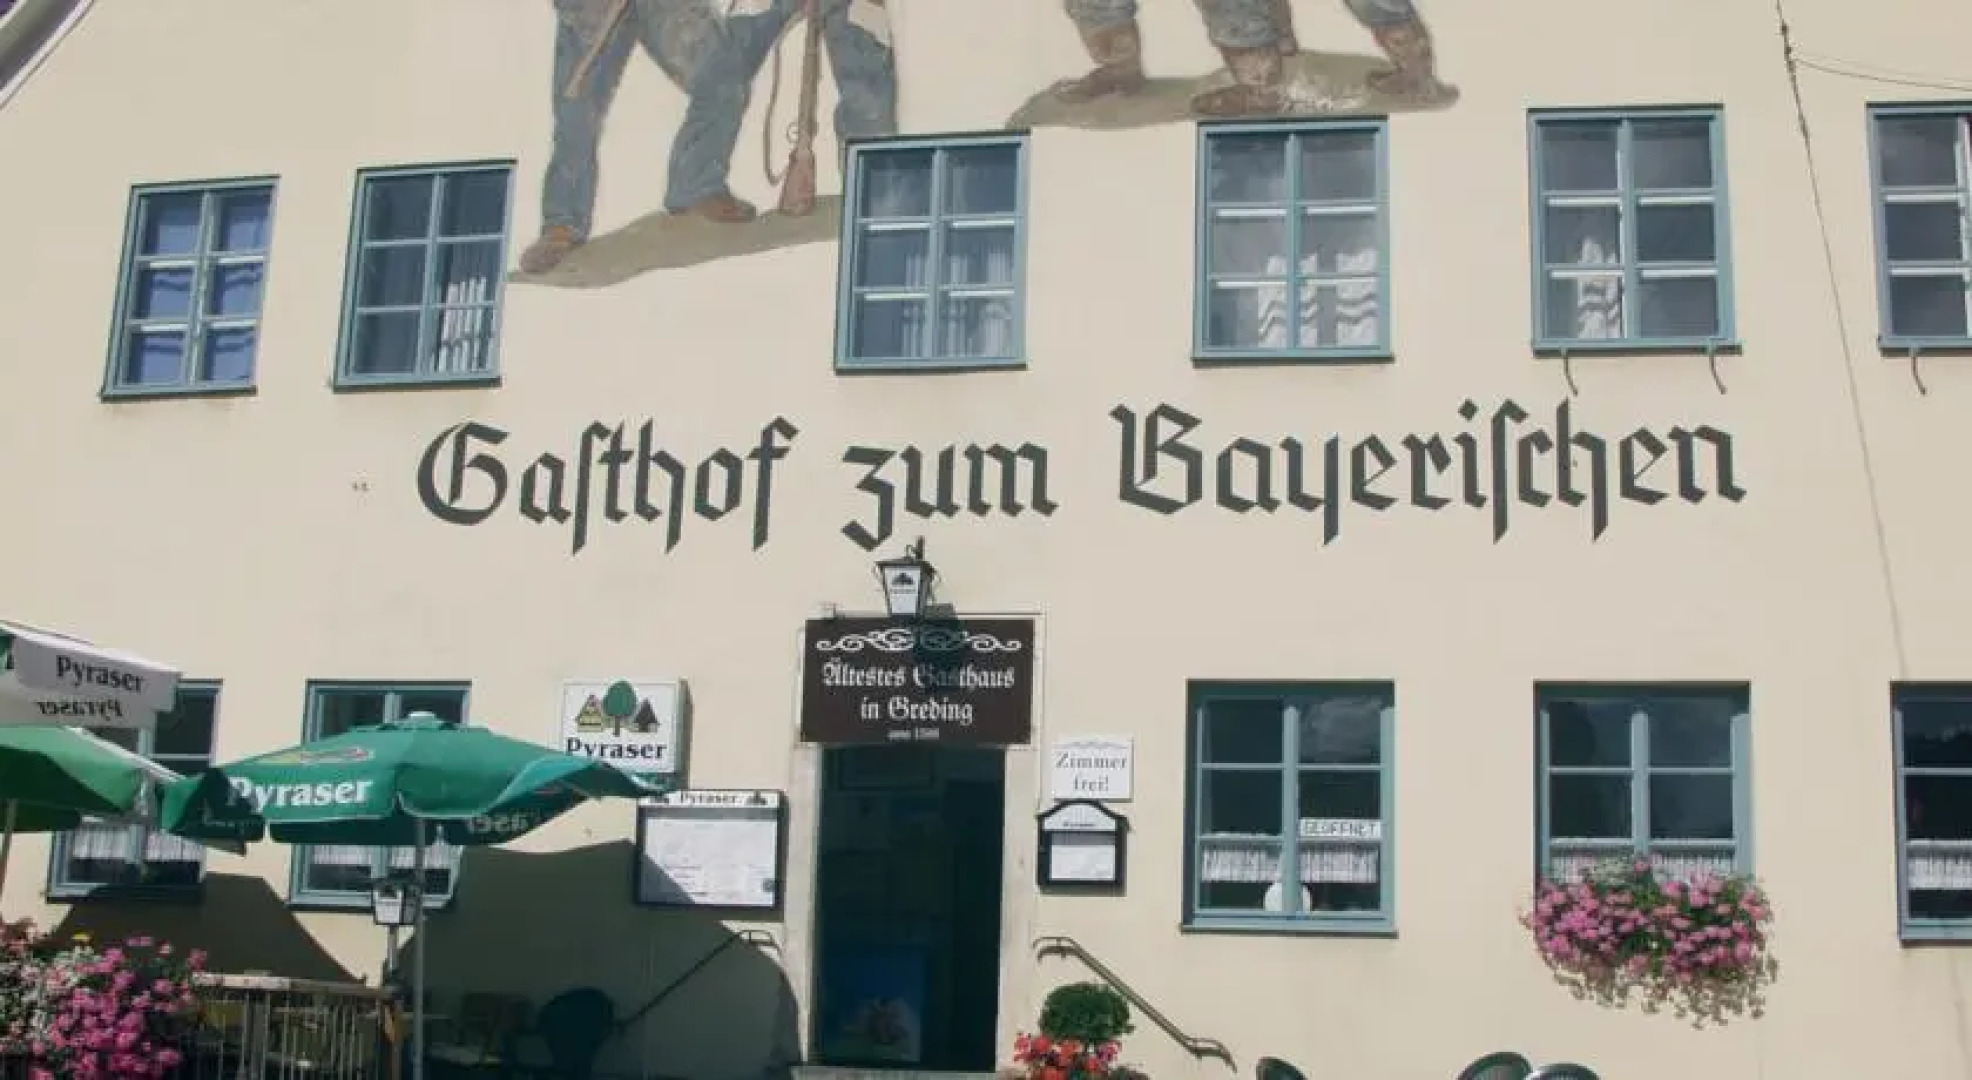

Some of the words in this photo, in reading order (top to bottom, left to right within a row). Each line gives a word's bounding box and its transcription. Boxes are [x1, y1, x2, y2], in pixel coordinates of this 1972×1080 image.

[841, 442, 1059, 552] zum
[56, 654, 145, 692] Pyraser
[823, 656, 906, 688] Ältestes
[861, 697, 879, 720] in
[887, 696, 973, 727] Greding
[566, 737, 668, 759] Pyraser
[1055, 751, 1128, 769] Zimmer
[225, 776, 374, 814] Pyraser
